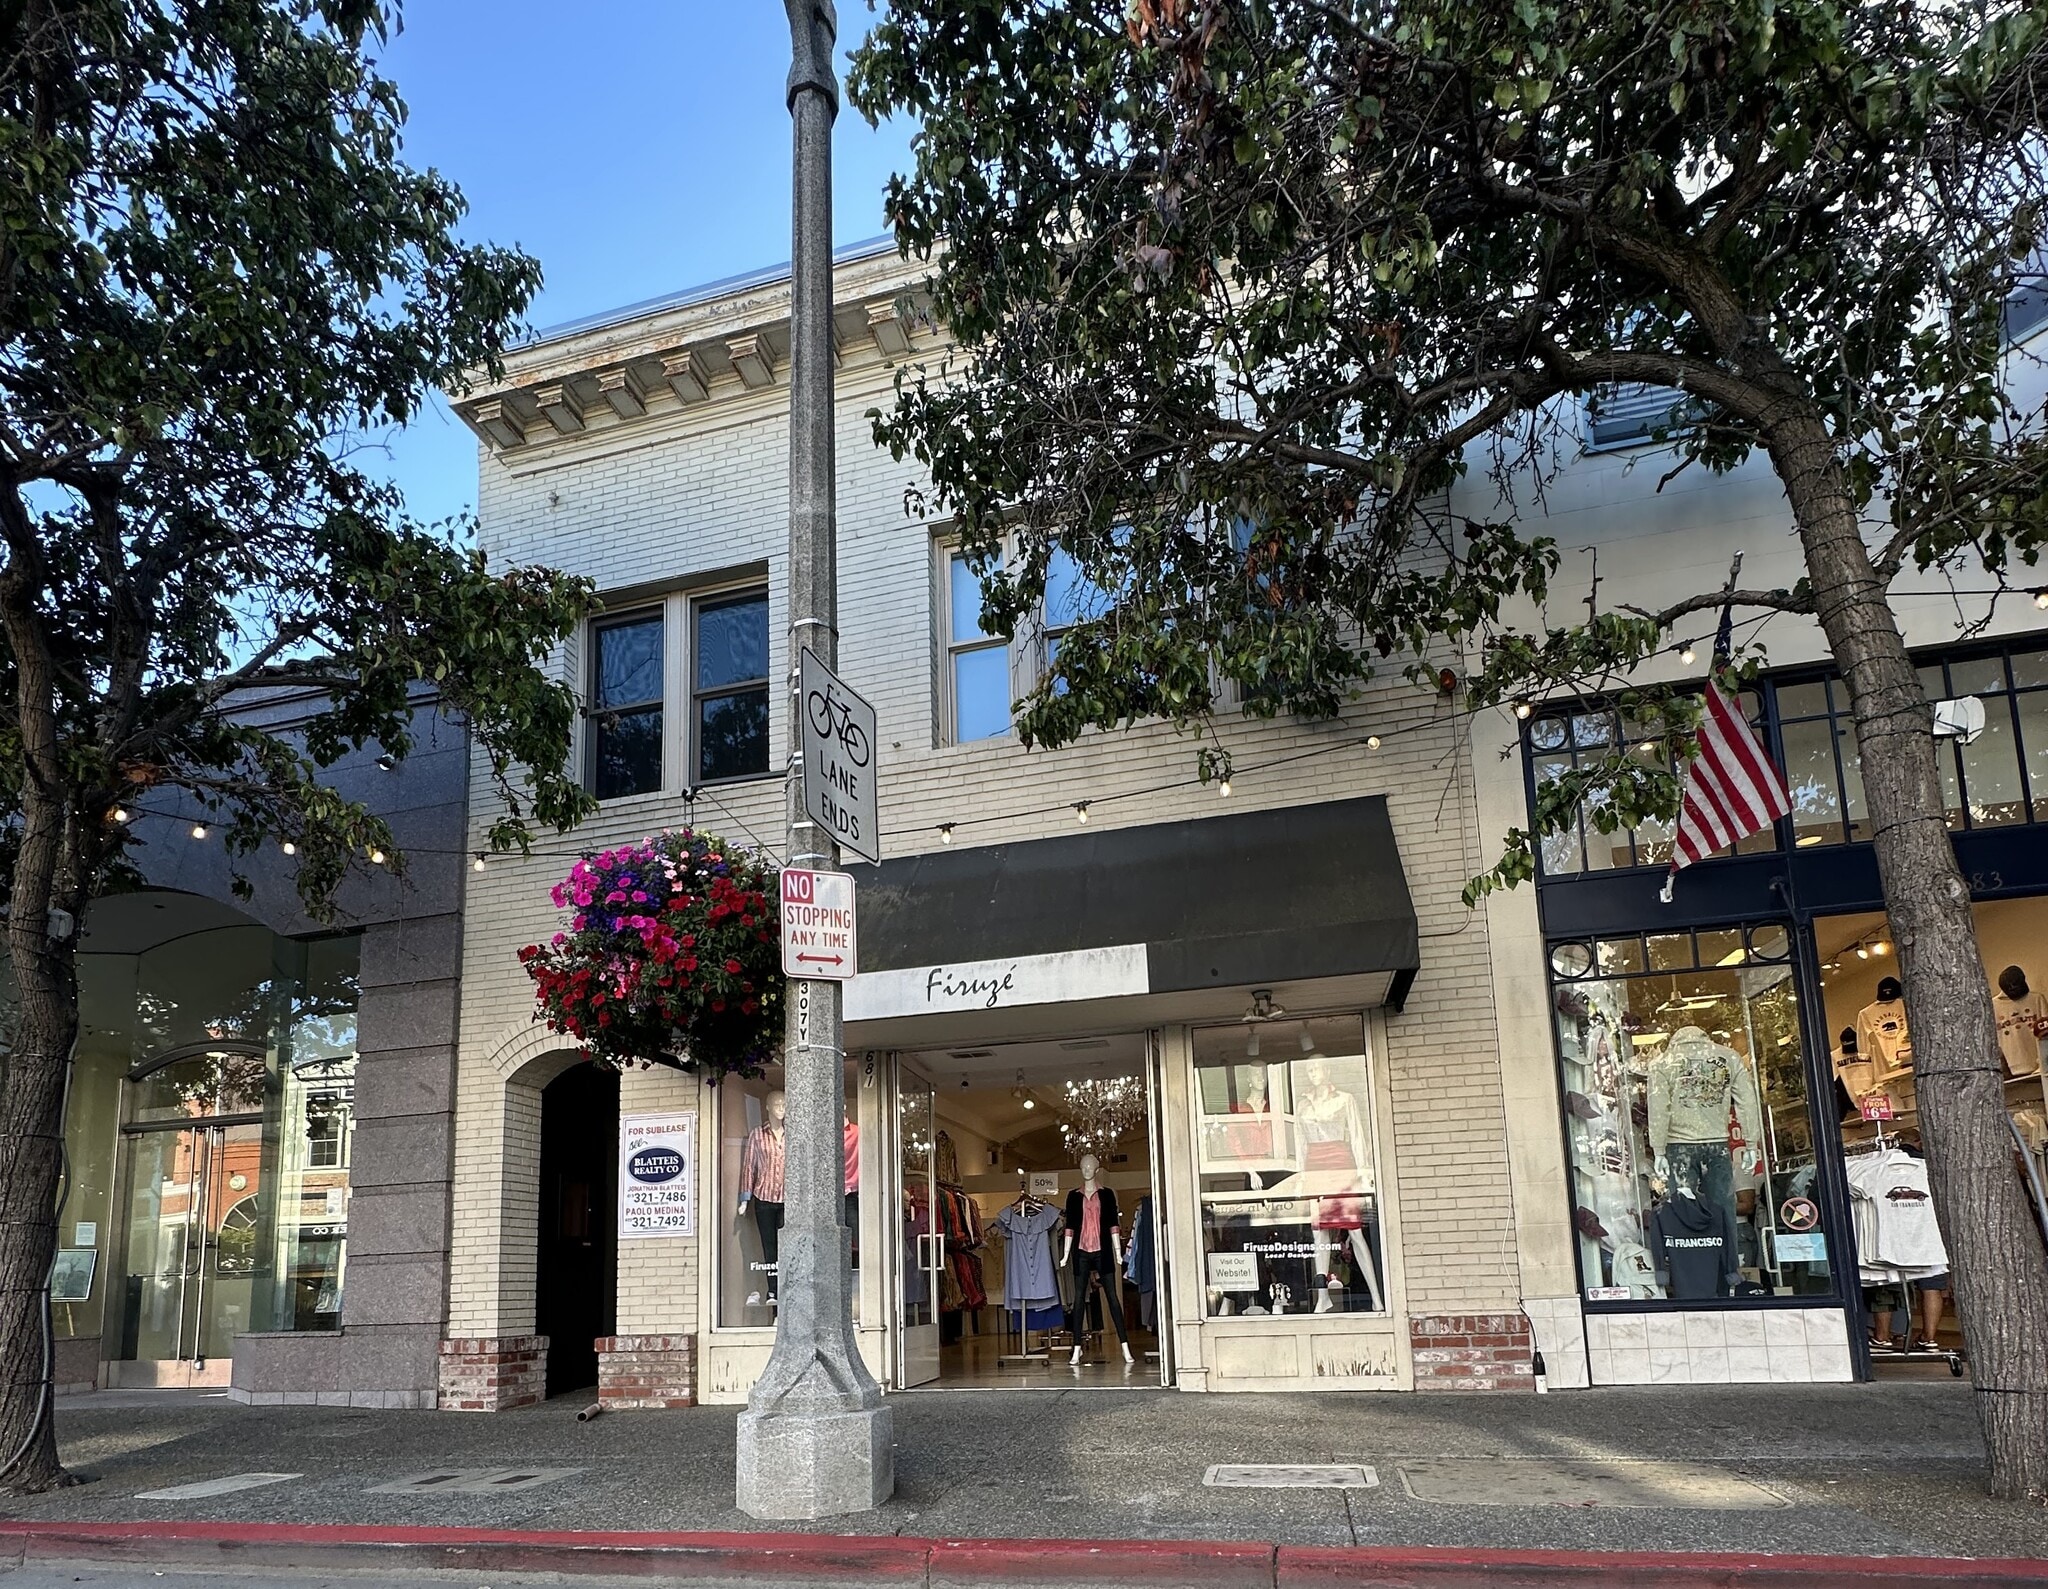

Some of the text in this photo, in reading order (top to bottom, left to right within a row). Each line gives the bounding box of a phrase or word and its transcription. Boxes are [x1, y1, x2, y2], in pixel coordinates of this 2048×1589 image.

[819, 750, 859, 801] LANE
[822, 792, 860, 841] ENDS
[786, 874, 811, 899] NO
[1966, 871, 2003, 891] 83
[786, 905, 851, 929] STOPPING
[790, 930, 848, 949] ANY TIME
[926, 963, 1017, 1008] Firuzé
[799, 981, 809, 1041] 307Y
[865, 1050, 875, 1088] 681
[628, 1124, 686, 1136] FOR SUBLEASE
[634, 1155, 679, 1167] BLATTEIS
[634, 1165, 680, 1175] REALTY CO
[1034, 1178, 1054, 1187] 50%
[633, 1191, 687, 1203] 321-7486
[625, 1206, 686, 1216] PAOLO MEDINA
[632, 1215, 686, 1228] 321-7492
[1243, 1241, 1341, 1253] FiruzeDesigns.com
[1674, 1236, 1724, 1248] FRANCISCO
[750, 1261, 779, 1271] Firuze
